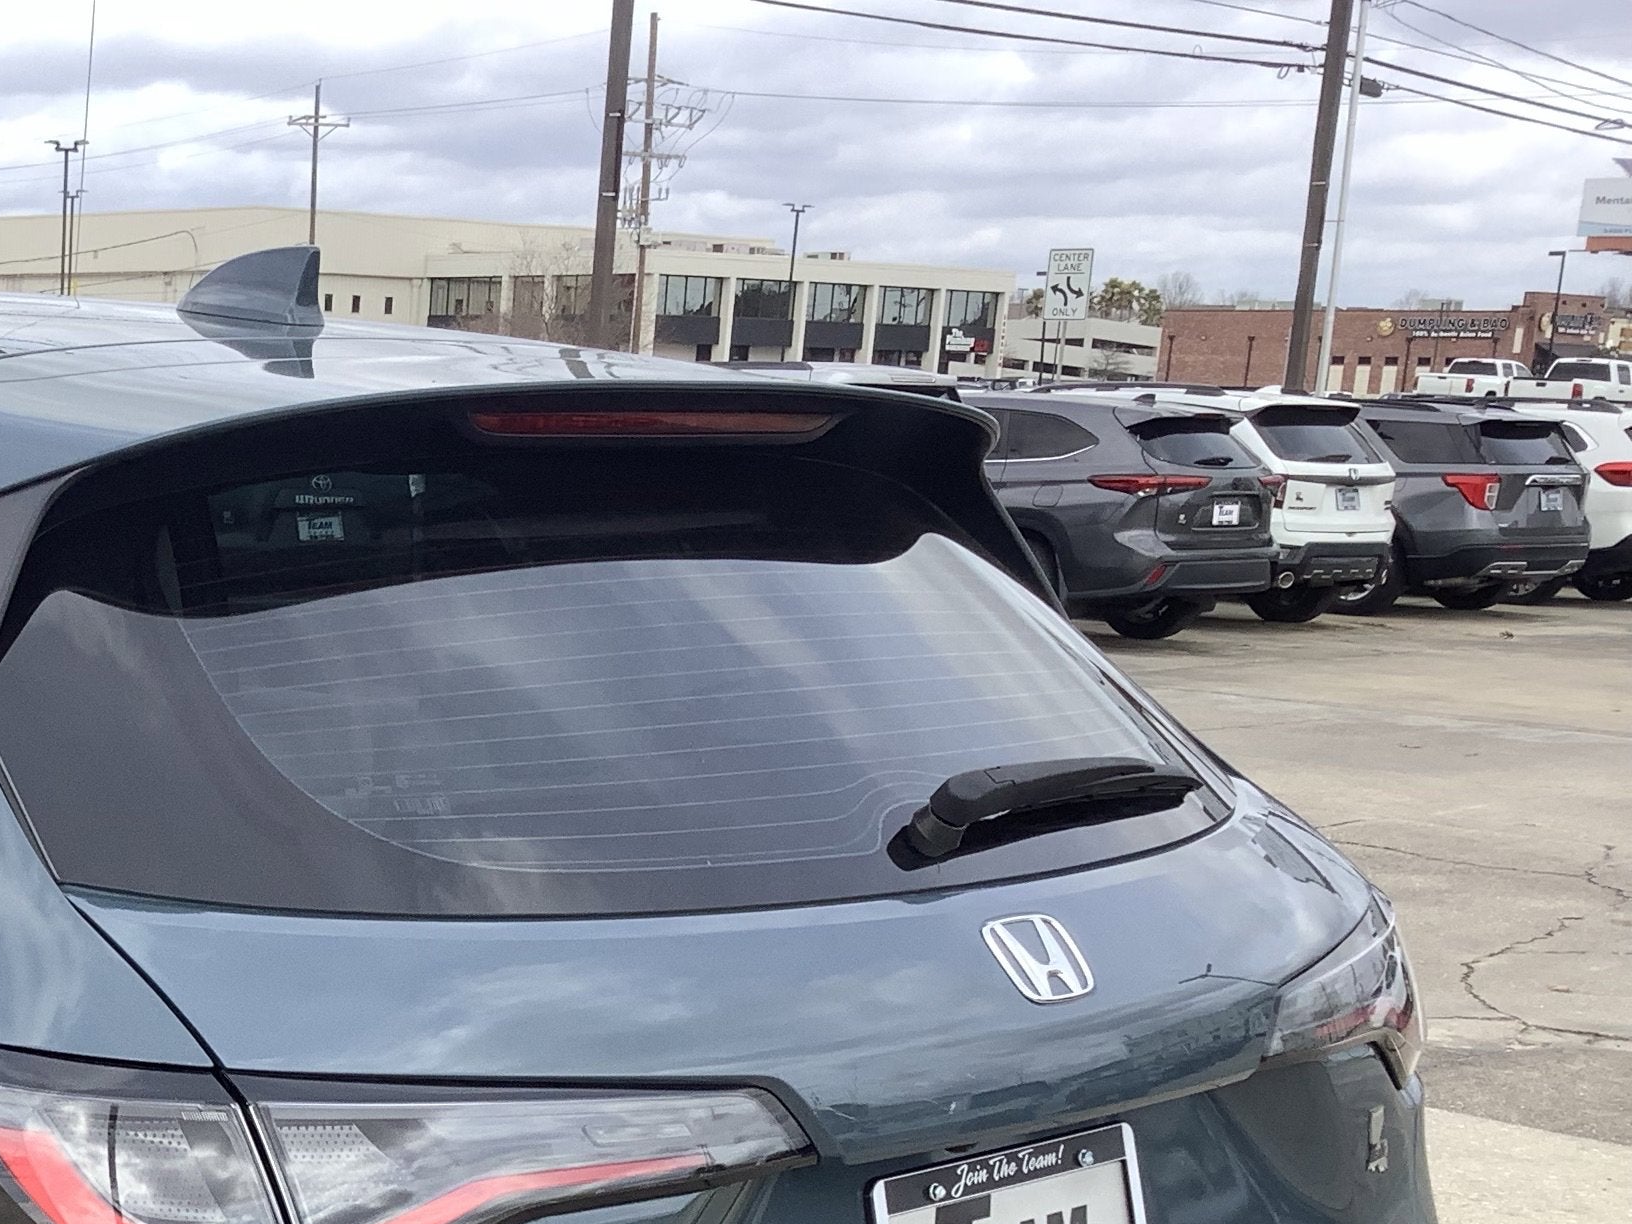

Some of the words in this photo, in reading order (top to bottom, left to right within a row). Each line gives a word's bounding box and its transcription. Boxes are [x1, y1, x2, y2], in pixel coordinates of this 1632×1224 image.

[1053, 252, 1090, 262] CENTER
[1057, 263, 1083, 272] LANE
[1051, 307, 1078, 317] ONLY
[1481, 318, 1510, 331] BAO
[951, 1163, 989, 1198] Join
[989, 1155, 1018, 1182] The
[1018, 1143, 1065, 1175] Team!
